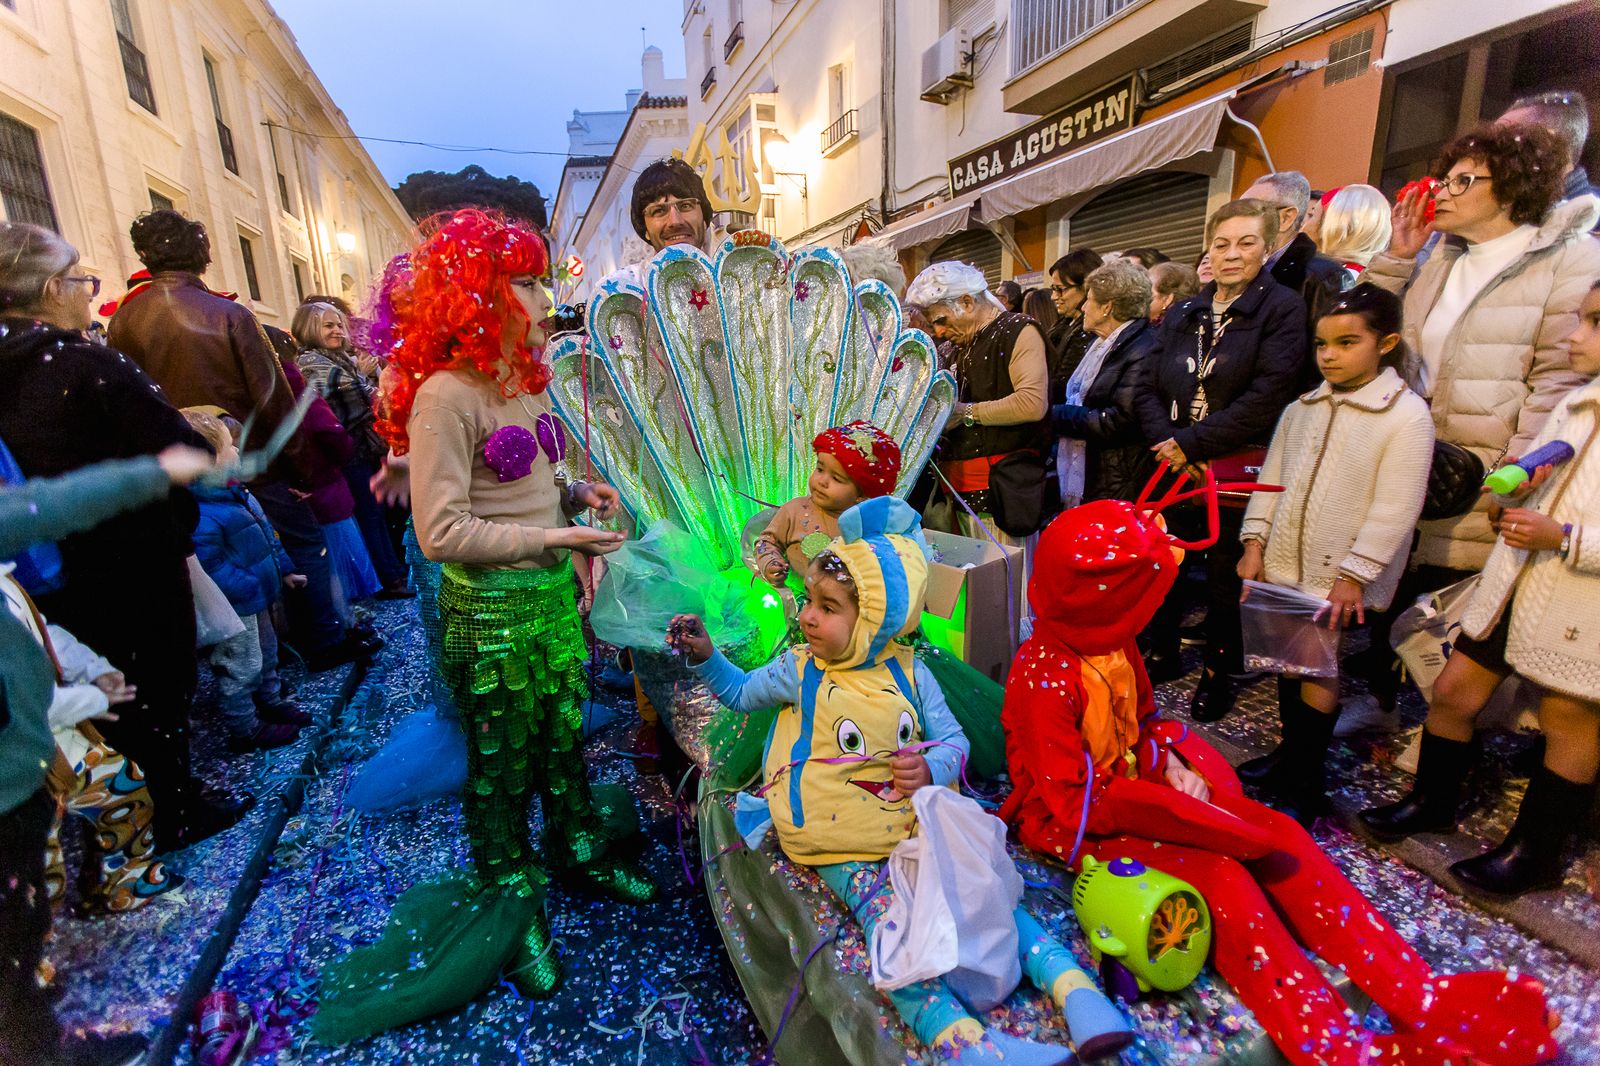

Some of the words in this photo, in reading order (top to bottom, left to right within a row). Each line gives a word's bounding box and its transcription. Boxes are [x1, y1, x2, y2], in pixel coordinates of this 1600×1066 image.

[952, 150, 1004, 191] CASA
[1010, 89, 1129, 168] AGUSTIN
[733, 229, 771, 247] 2020
